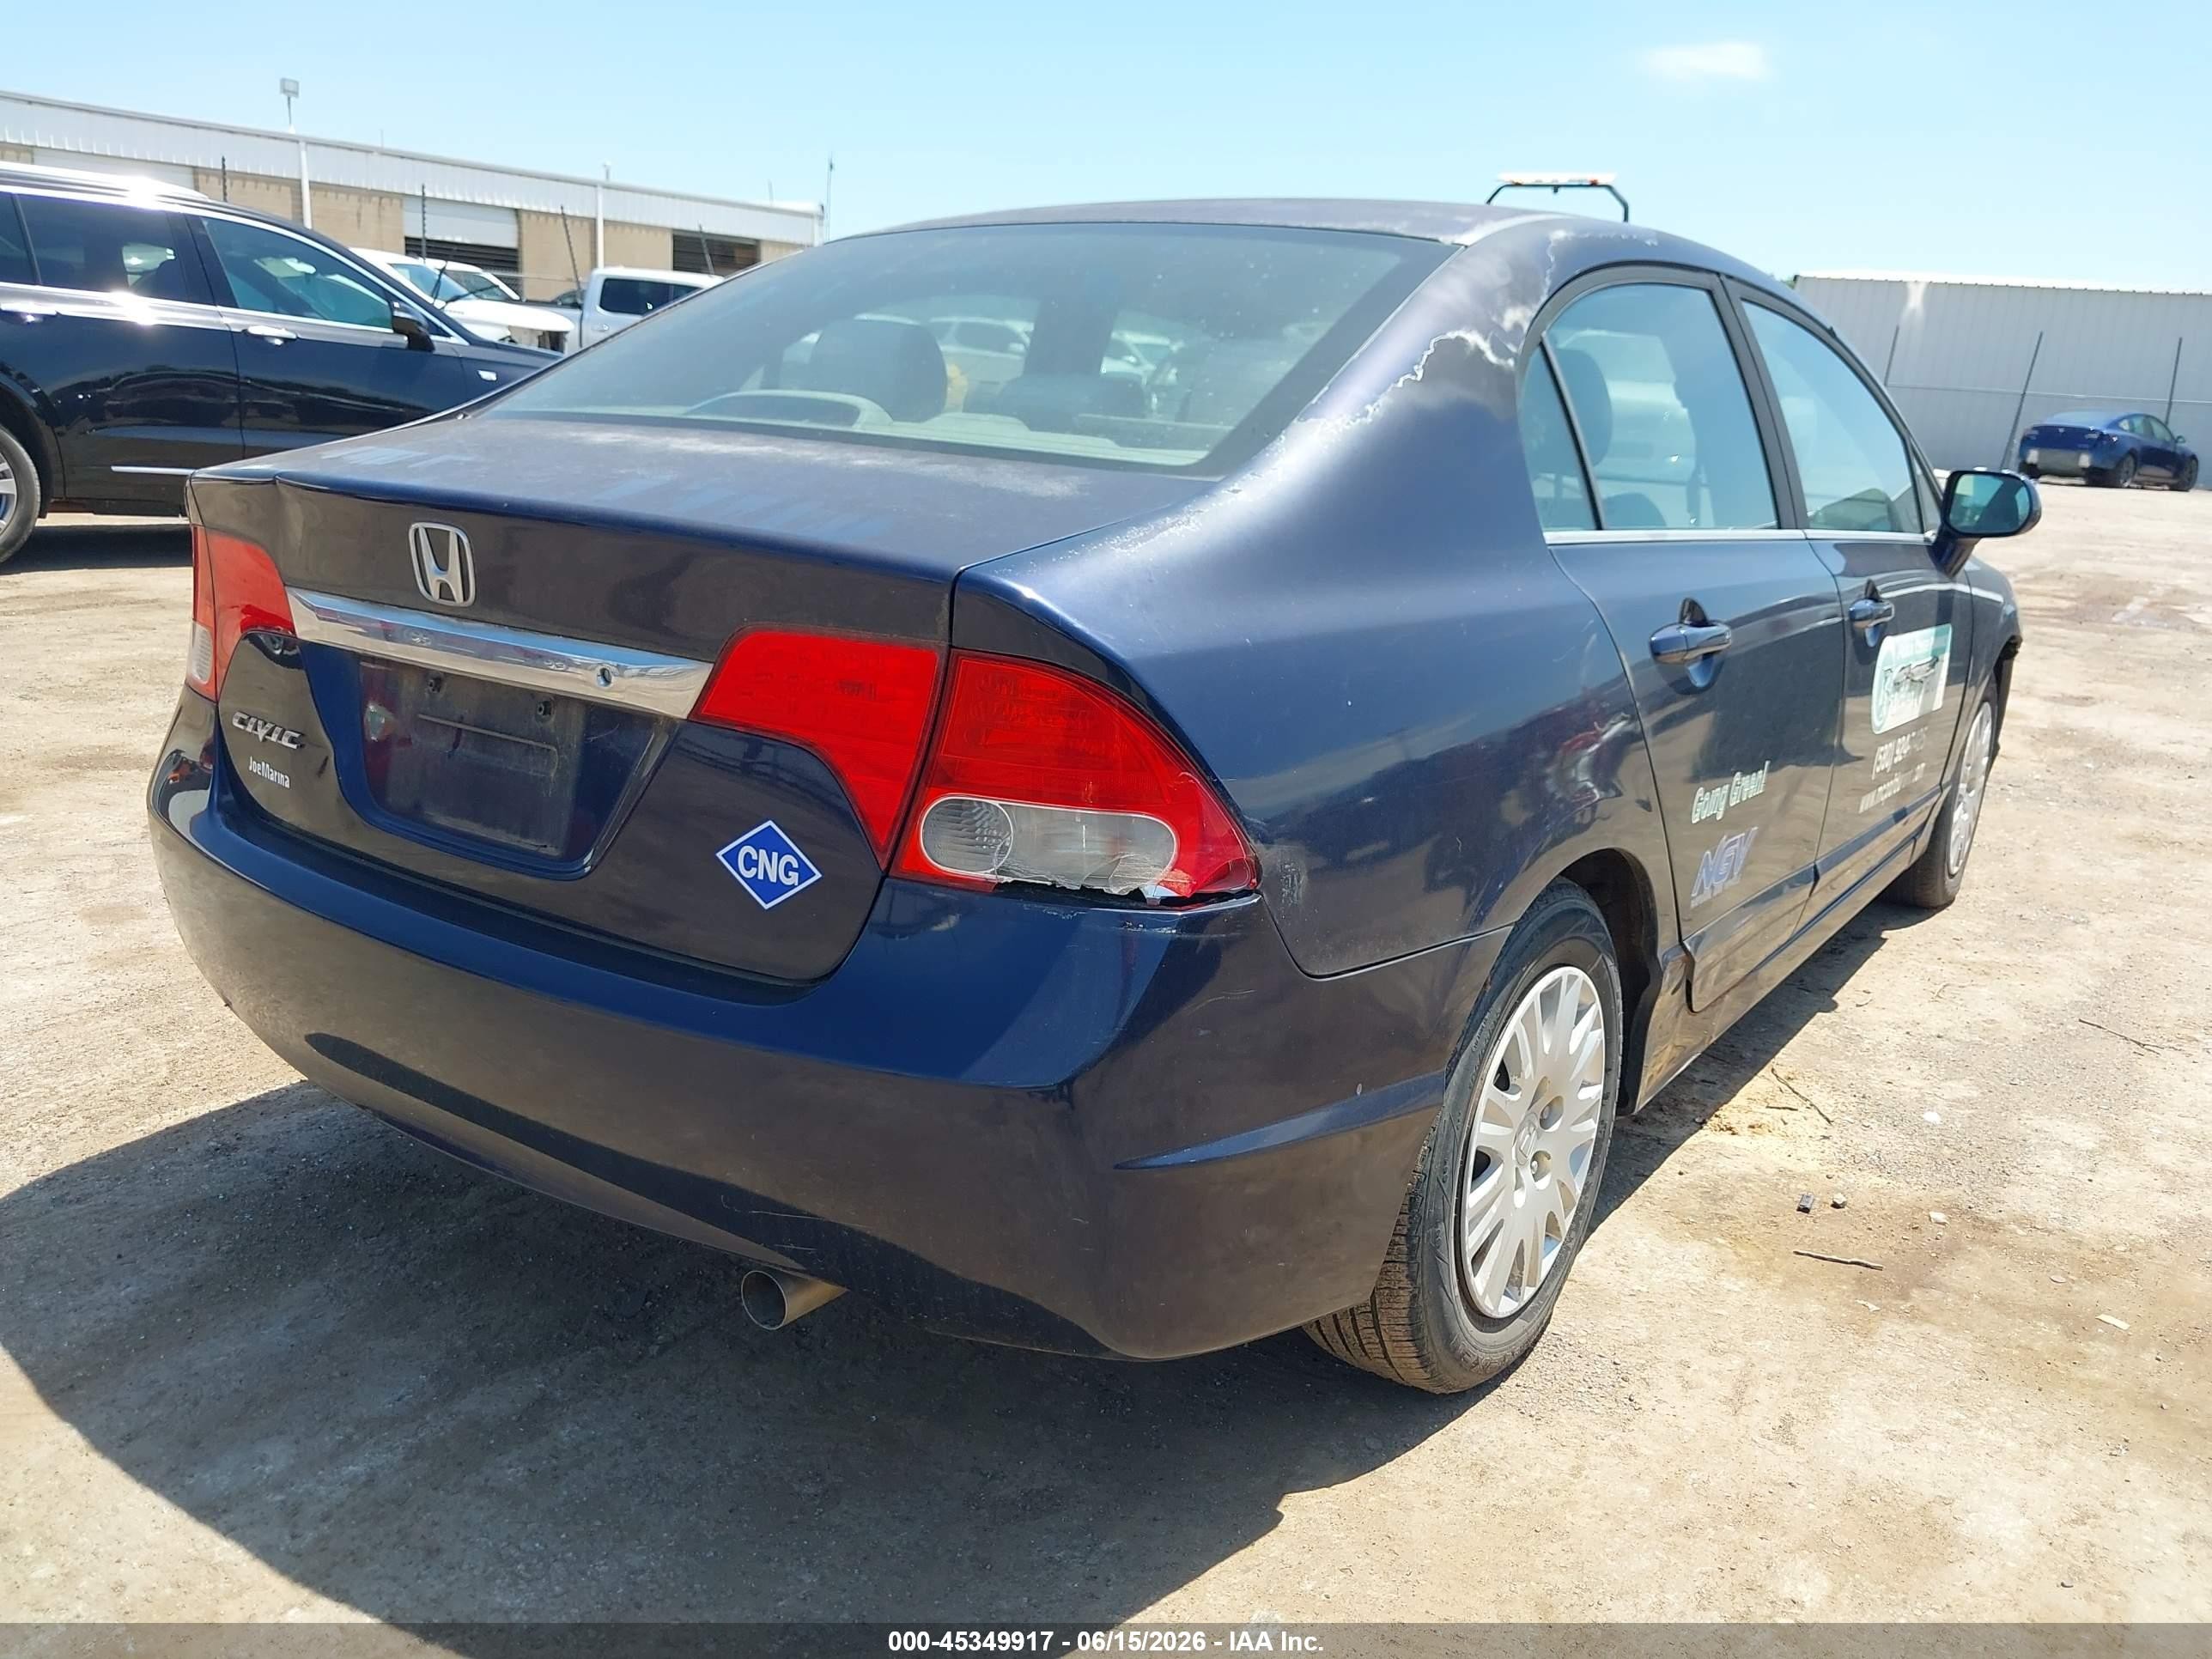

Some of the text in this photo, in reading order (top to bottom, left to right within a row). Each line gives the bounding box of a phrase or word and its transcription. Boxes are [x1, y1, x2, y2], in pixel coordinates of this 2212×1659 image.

[232, 711, 303, 750] CIVIC
[248, 755, 290, 788] JoeMarina
[1691, 784, 1730, 824] Going
[738, 845, 799, 886] CNG
